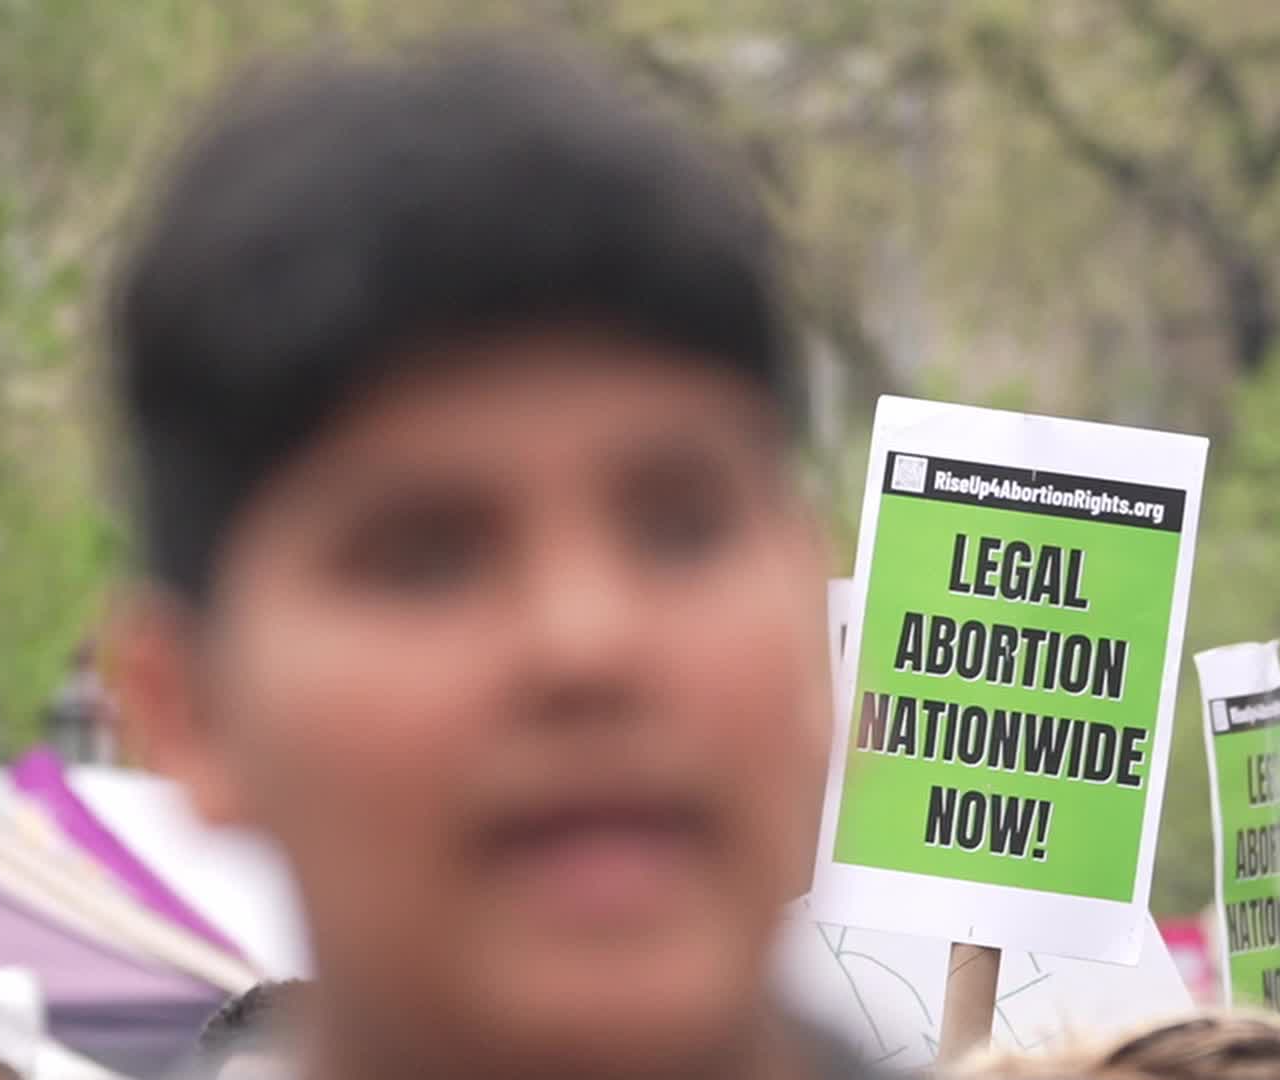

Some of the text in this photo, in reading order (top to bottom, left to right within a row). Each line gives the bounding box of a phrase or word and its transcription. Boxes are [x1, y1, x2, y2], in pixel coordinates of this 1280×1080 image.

[933, 469, 1165, 524] RiseUp4AbortionRights.org
[949, 533, 1089, 609] LEGAL
[895, 612, 1128, 699] ABORTION
[856, 691, 1148, 787] NATIONWIDE
[924, 785, 1054, 860] NOW!
